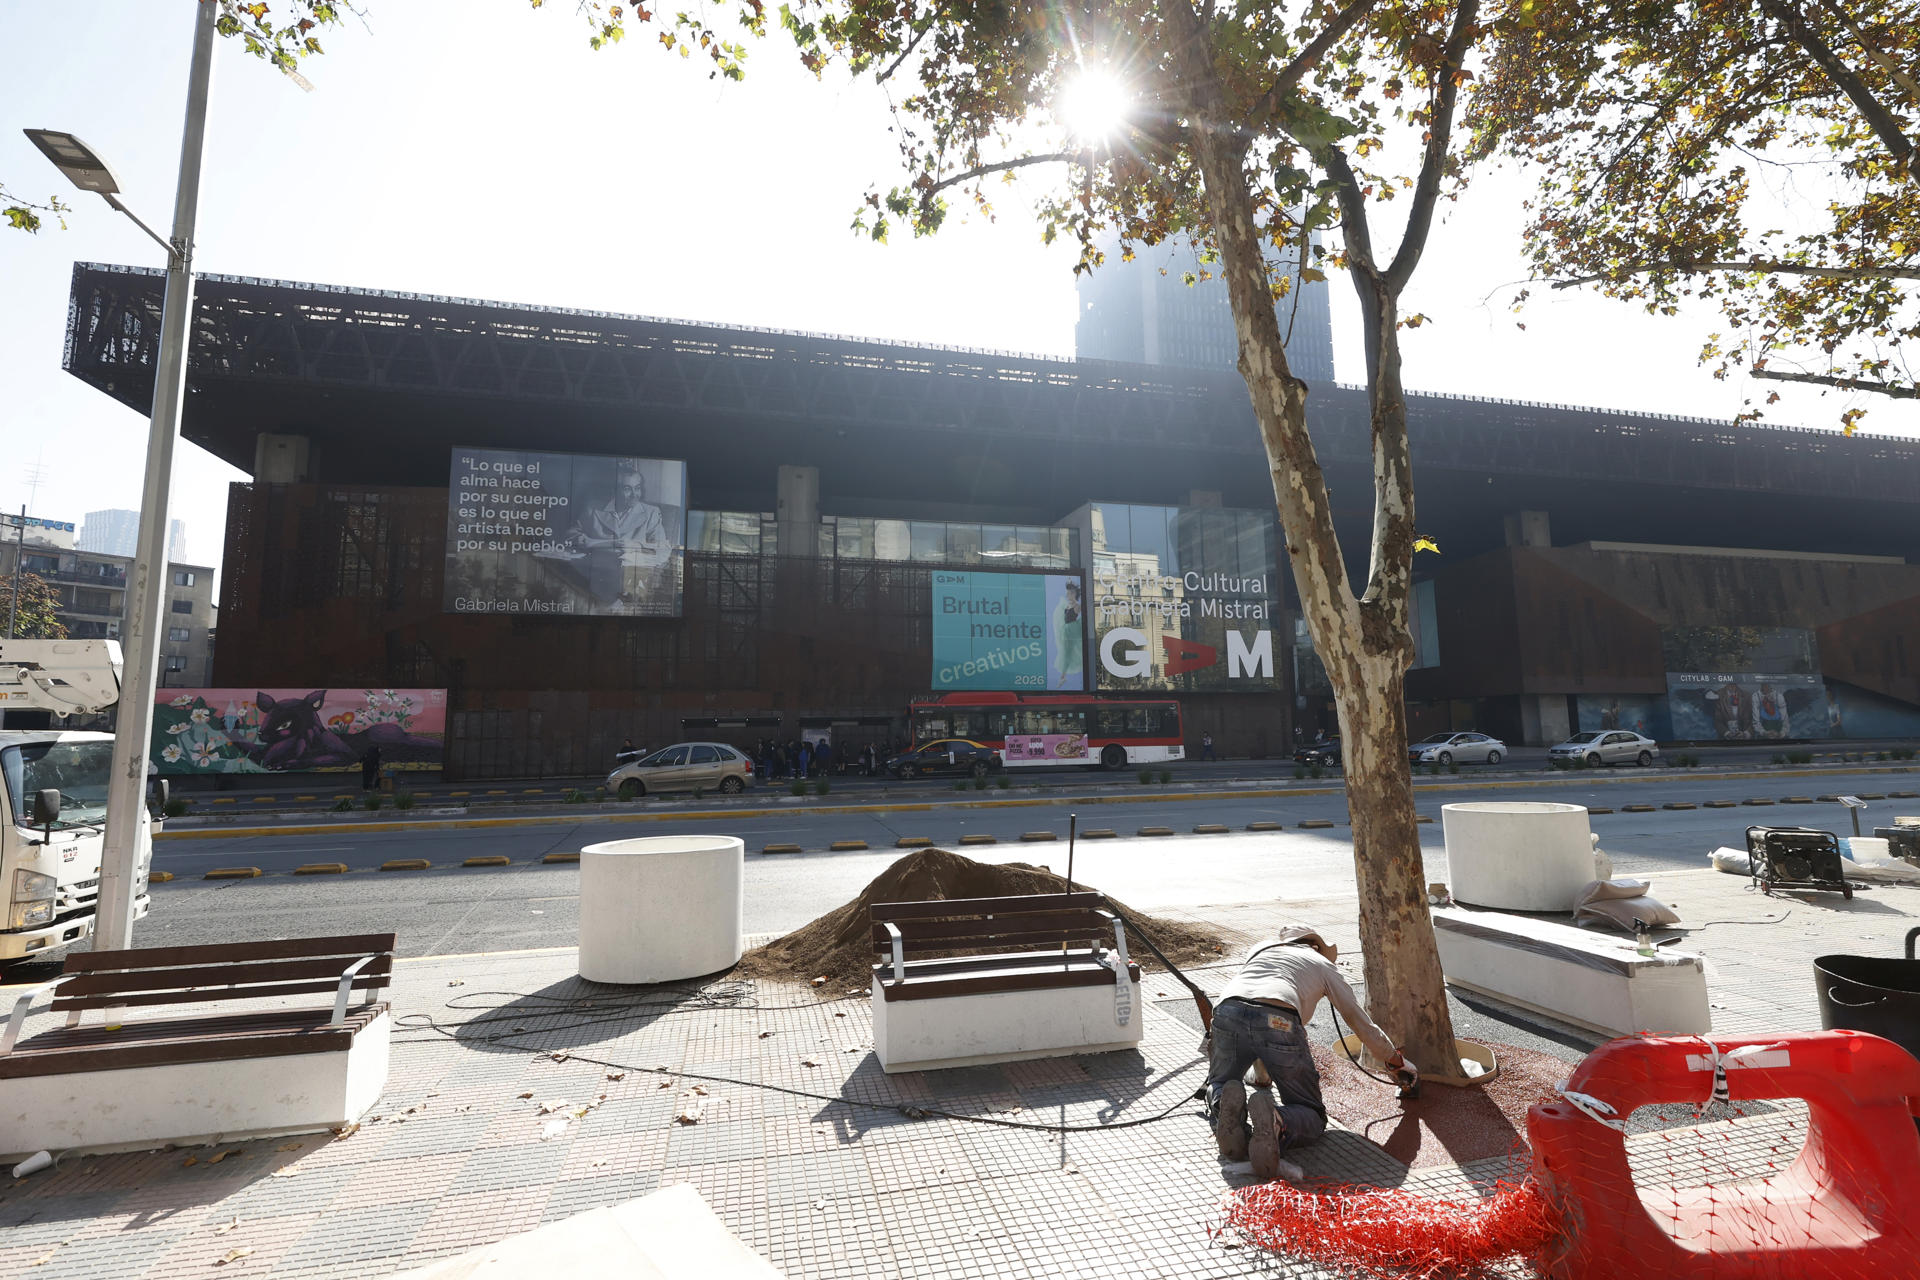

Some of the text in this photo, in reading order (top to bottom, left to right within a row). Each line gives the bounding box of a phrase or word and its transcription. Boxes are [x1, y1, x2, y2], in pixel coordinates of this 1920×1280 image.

[493, 462, 523, 475] que
[527, 462, 540, 474] el
[460, 474, 541, 489] alma hace
[460, 492, 568, 508] por su cuerpo
[458, 506, 546, 522] es lo que el
[457, 522, 553, 536] artista hace
[457, 539, 485, 552] por
[488, 540, 507, 550] su
[1100, 570, 1267, 593] Centro Cultural
[455, 597, 574, 614] Gabriela Mistral
[943, 596, 1009, 615] Brutal
[1100, 595, 1269, 619] Gabriela Mistral
[971, 621, 1042, 638] mente
[939, 642, 1042, 683] creativos
[1014, 675, 1045, 685] 2026
